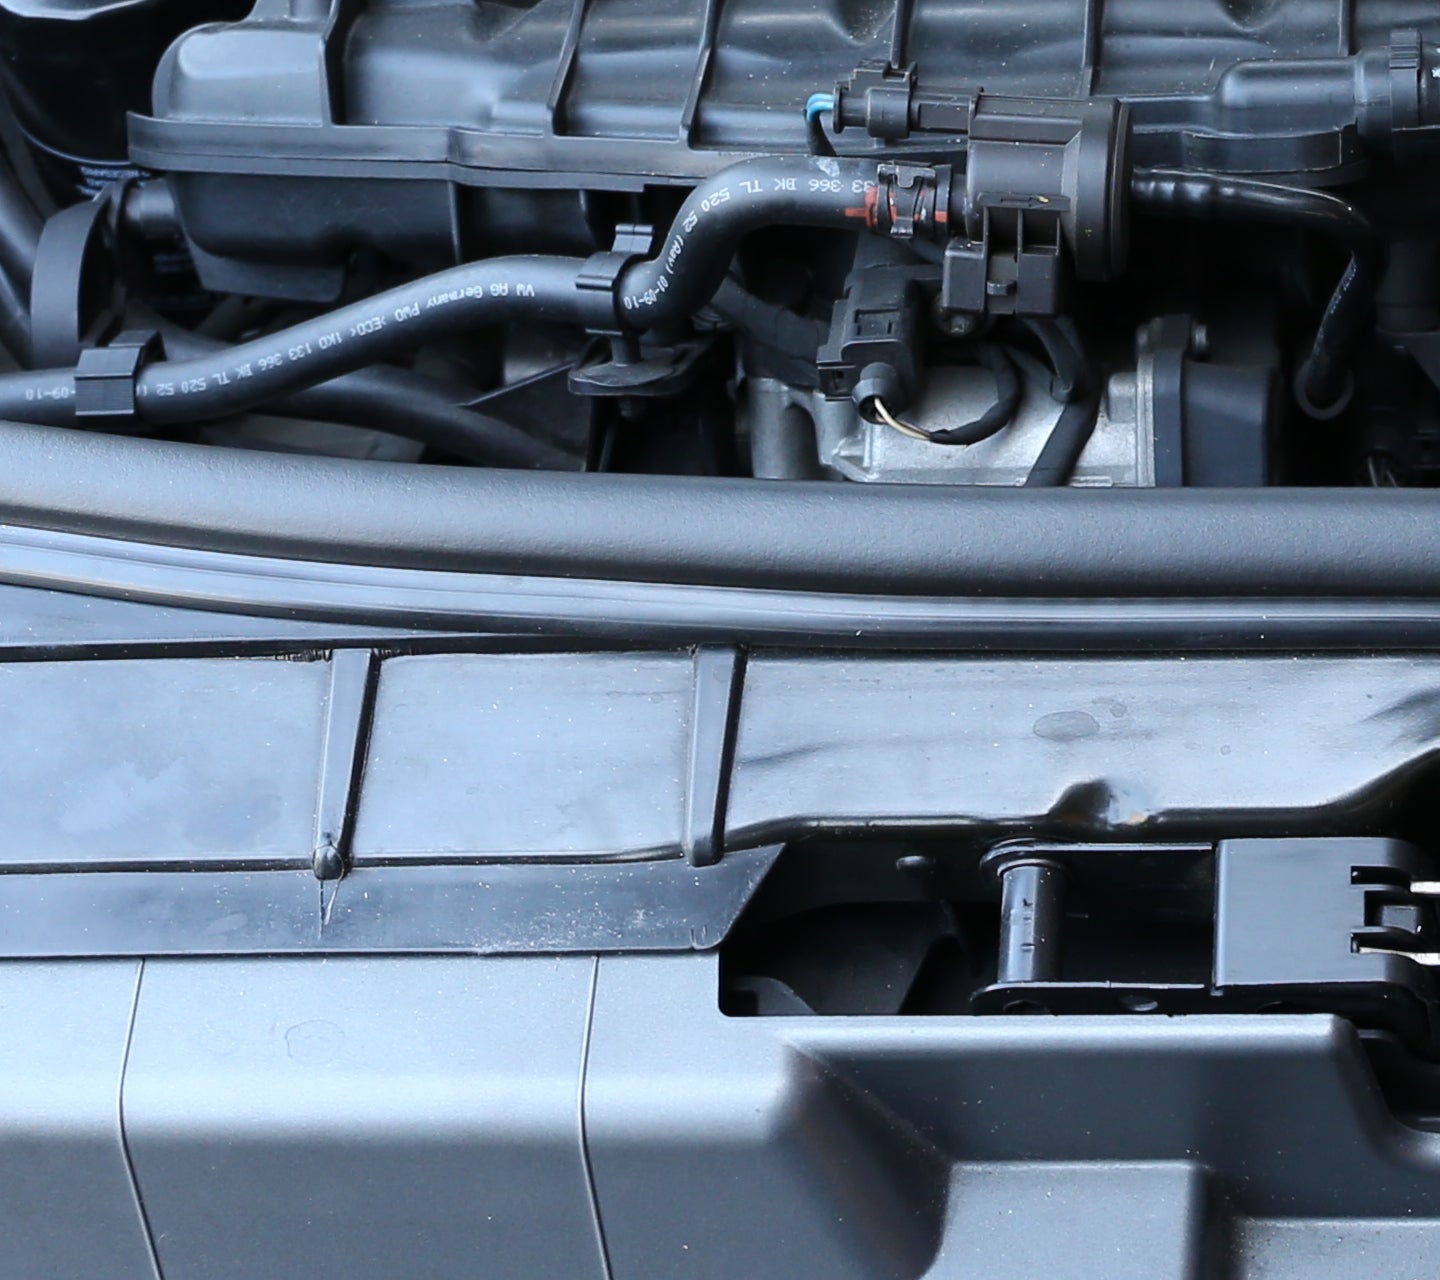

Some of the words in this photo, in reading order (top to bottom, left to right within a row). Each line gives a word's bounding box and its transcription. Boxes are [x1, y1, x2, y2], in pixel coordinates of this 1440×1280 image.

[739, 179, 763, 193] TL
[774, 176, 797, 193] BK
[809, 177, 842, 194] 366
[700, 187, 731, 212] 520
[425, 283, 485, 310] Germany
[490, 284, 509, 298] AG
[516, 284, 535, 298] VW
[624, 276, 669, 311] 01-09-10
[288, 342, 314, 361] 133
[256, 354, 283, 371] 366
[180, 378, 207, 393] 520
[211, 371, 229, 385] TL
